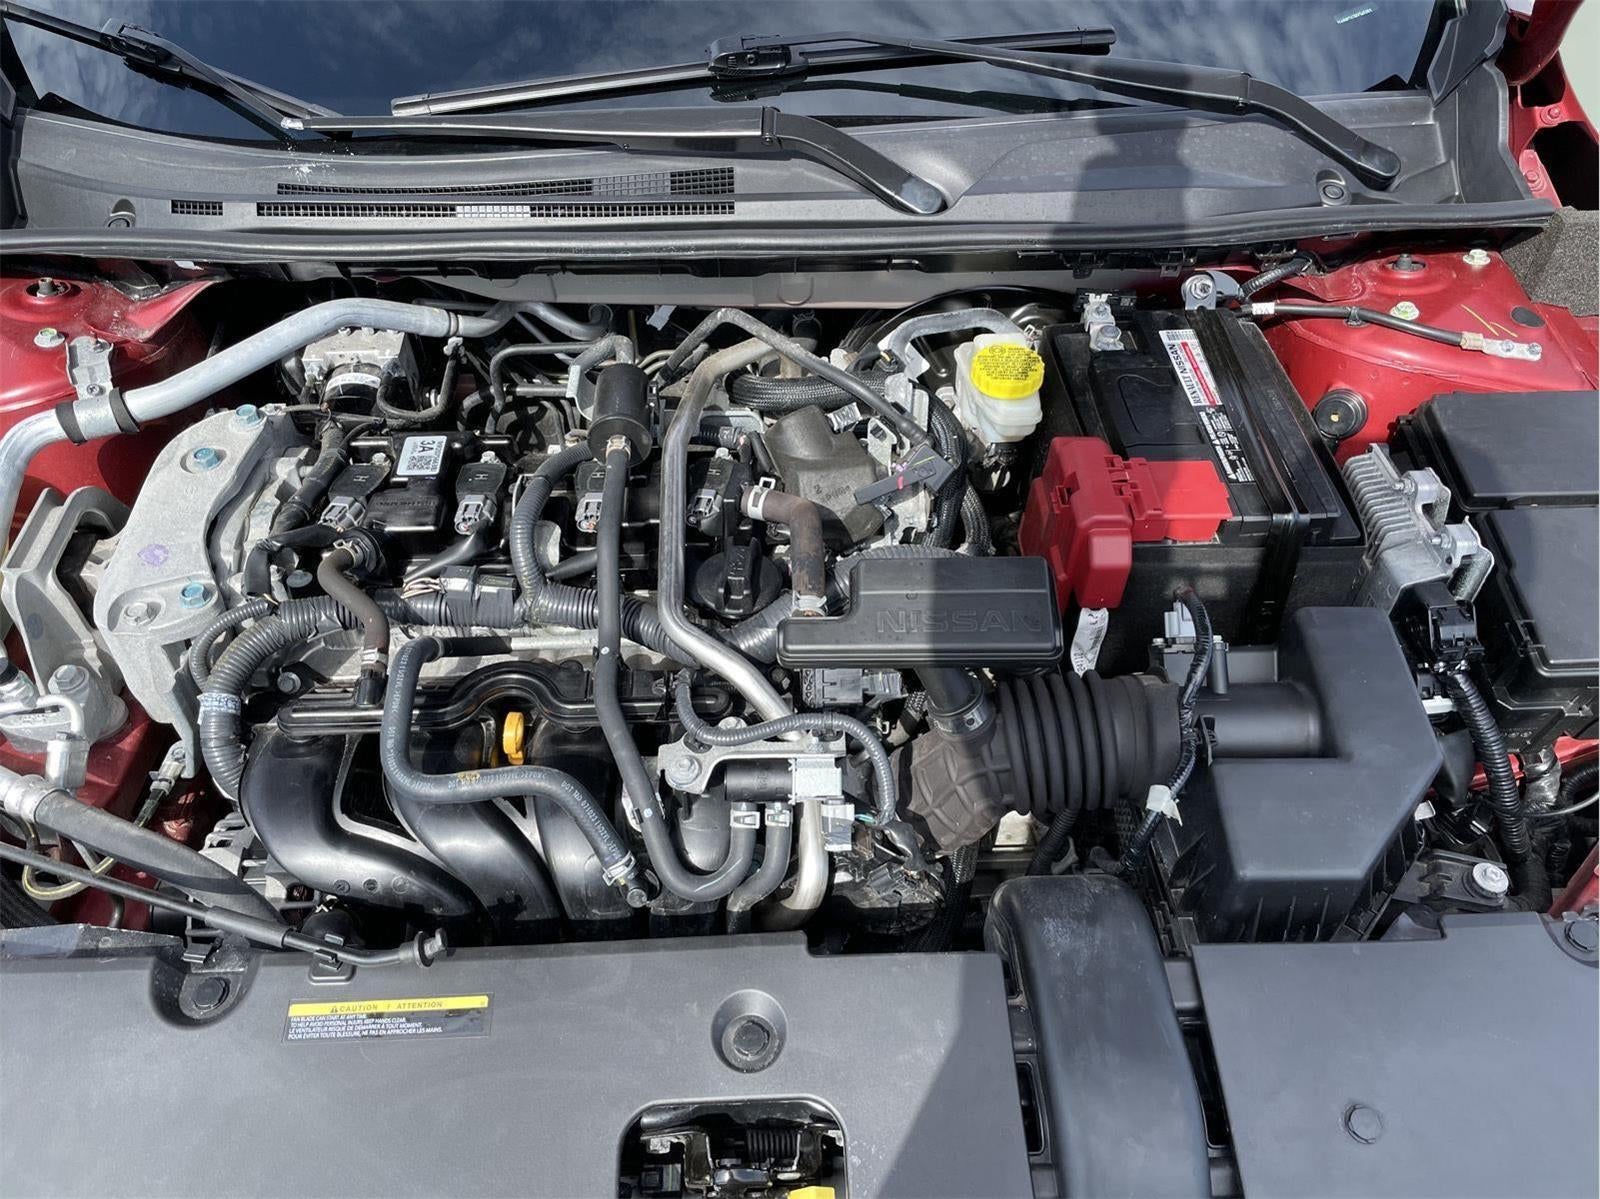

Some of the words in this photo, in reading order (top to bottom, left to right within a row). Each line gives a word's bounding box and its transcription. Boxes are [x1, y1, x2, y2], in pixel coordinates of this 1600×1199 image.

[1167, 343, 1188, 374] NISSAN
[417, 440, 436, 453] 3A
[876, 608, 1042, 633] NISSAN
[340, 1004, 378, 1012] CAUTION
[397, 1001, 443, 1009] ATTENTION
